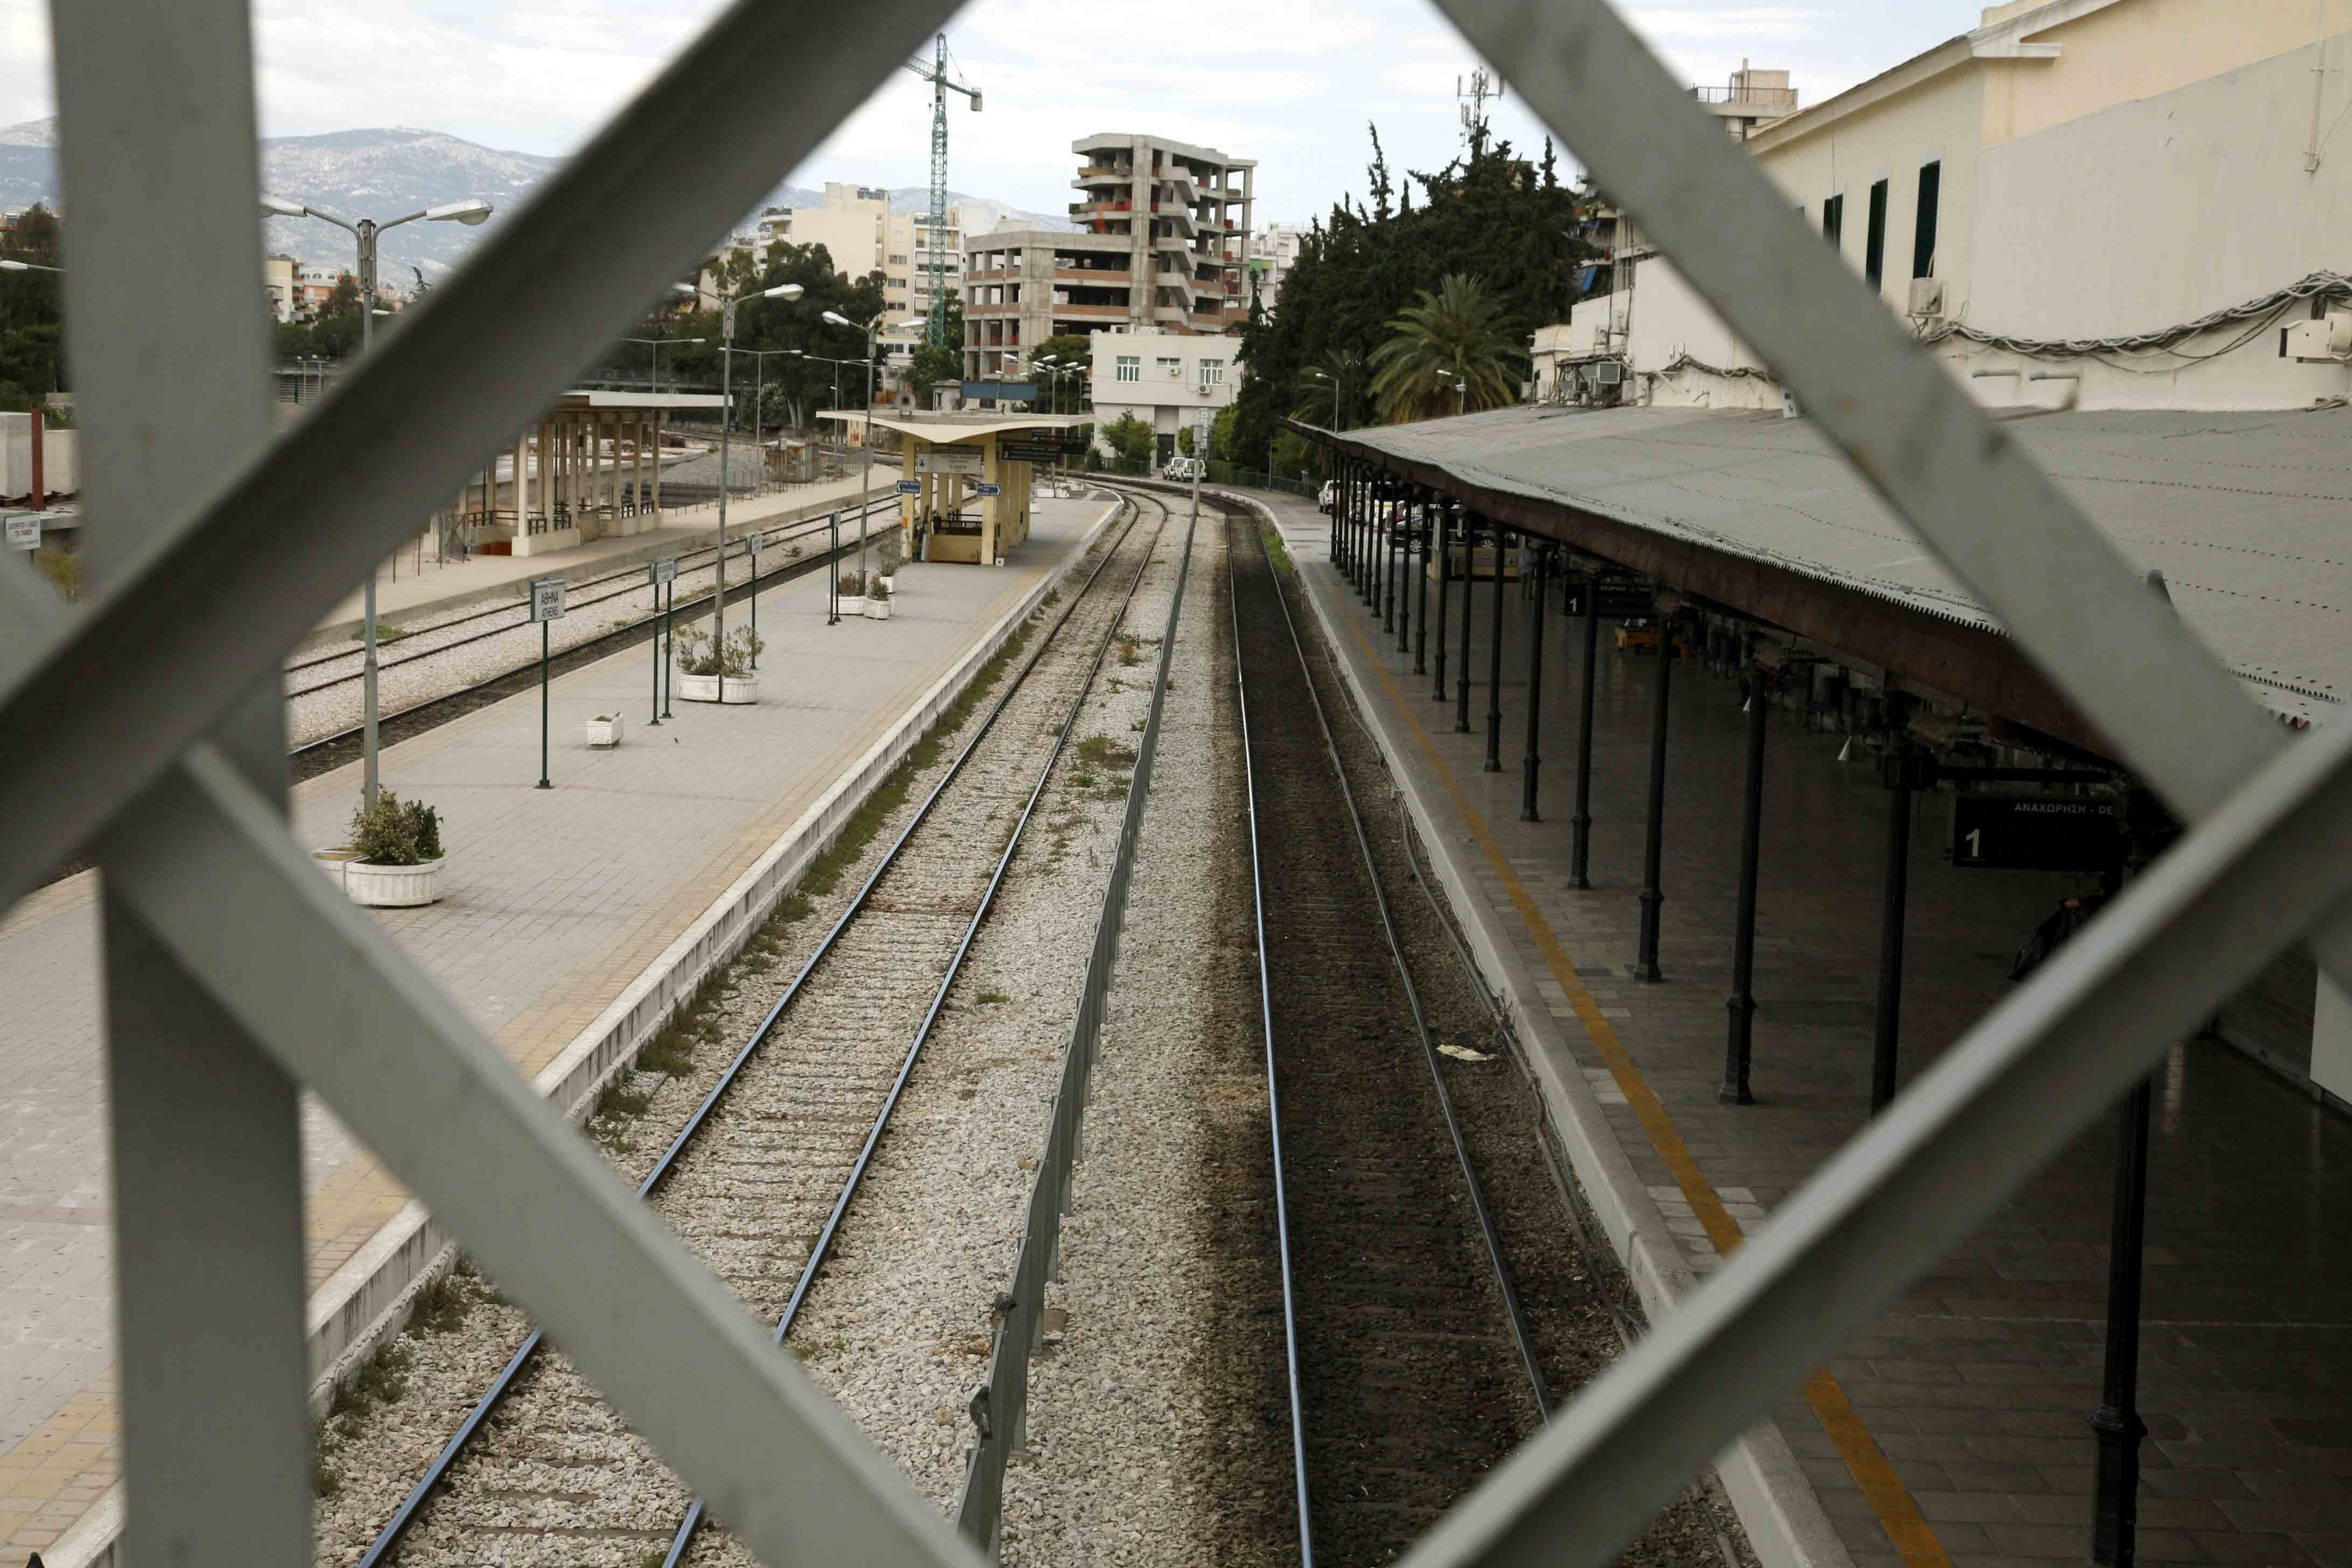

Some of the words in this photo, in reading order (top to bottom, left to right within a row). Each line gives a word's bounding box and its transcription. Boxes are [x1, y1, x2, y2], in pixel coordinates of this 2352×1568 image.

[541, 591, 559, 604] ΑΘΗΝΑ
[1569, 597, 1578, 613] 1
[2014, 802, 2086, 814] ΑΝΑΧΩΡΗΣΗ
[1965, 828, 1981, 857] 1
